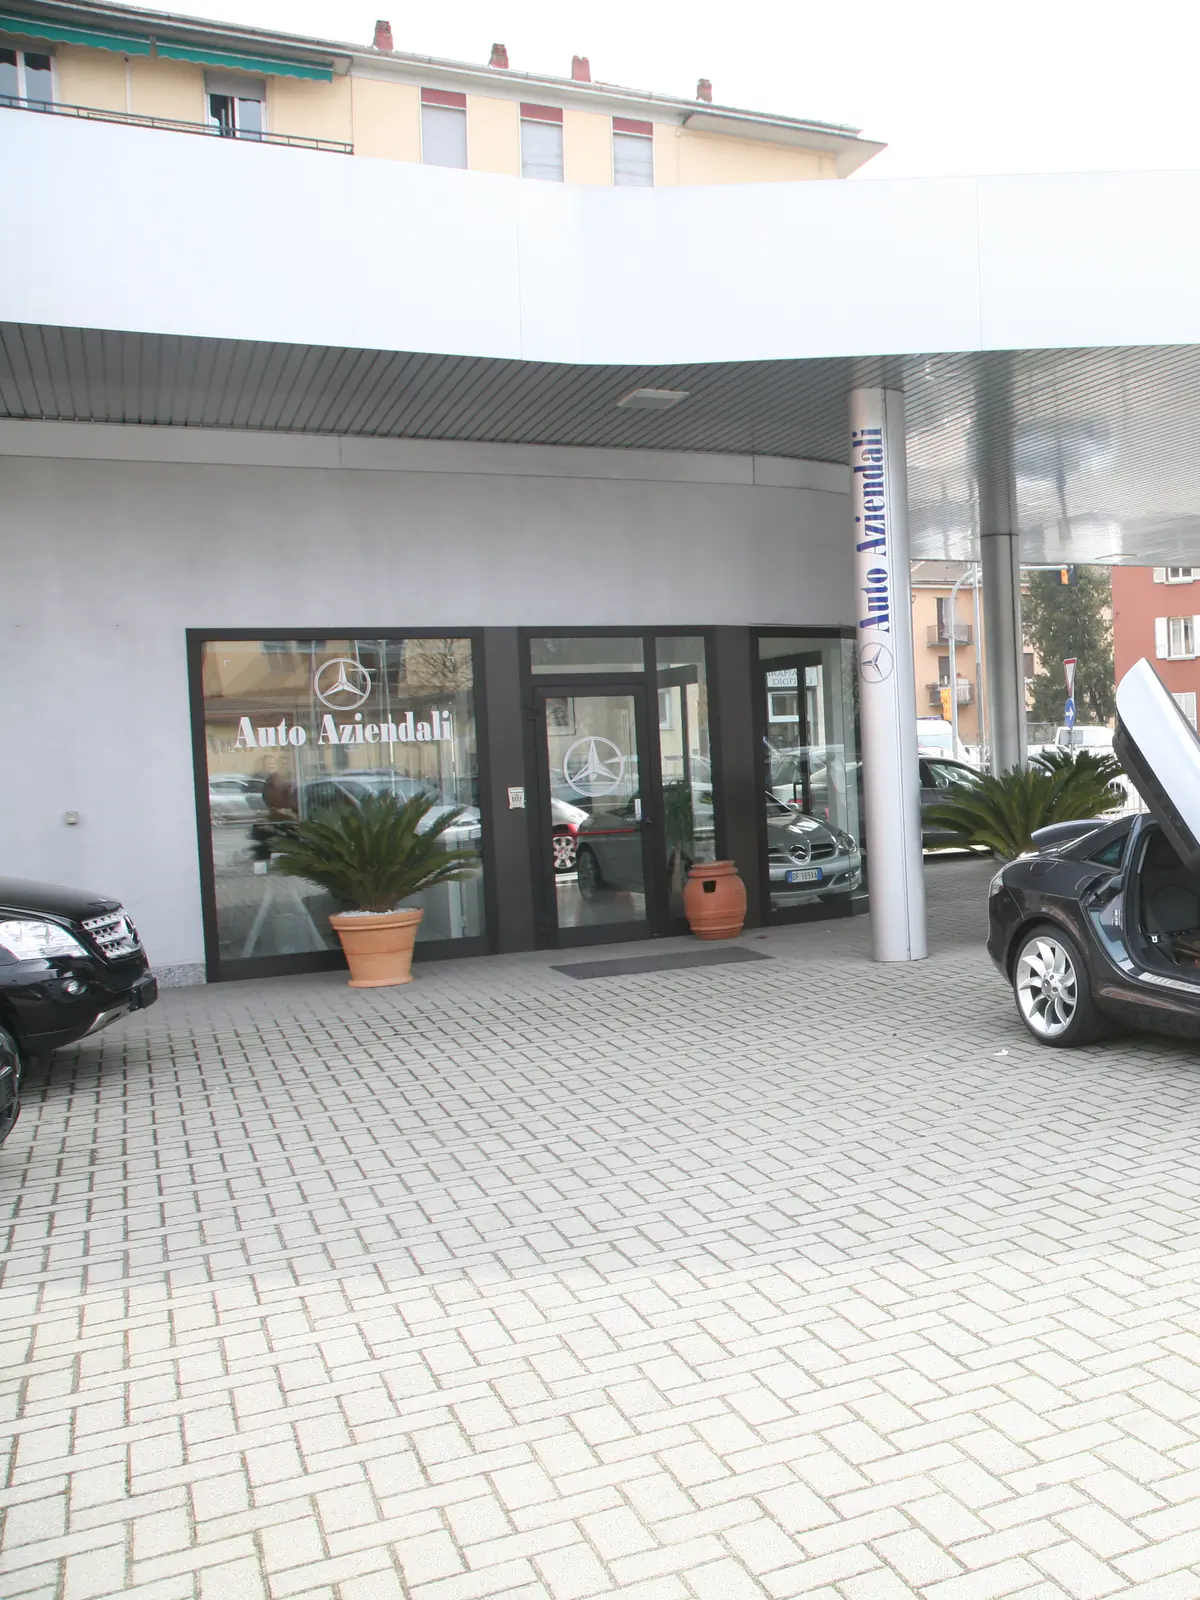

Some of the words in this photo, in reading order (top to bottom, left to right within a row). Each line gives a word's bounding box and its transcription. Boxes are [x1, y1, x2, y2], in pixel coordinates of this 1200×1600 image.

[852, 427, 889, 557] Aziendali
[858, 567, 891, 634] Auto
[234, 716, 307, 748] Auto
[317, 710, 452, 745] Aziendali
